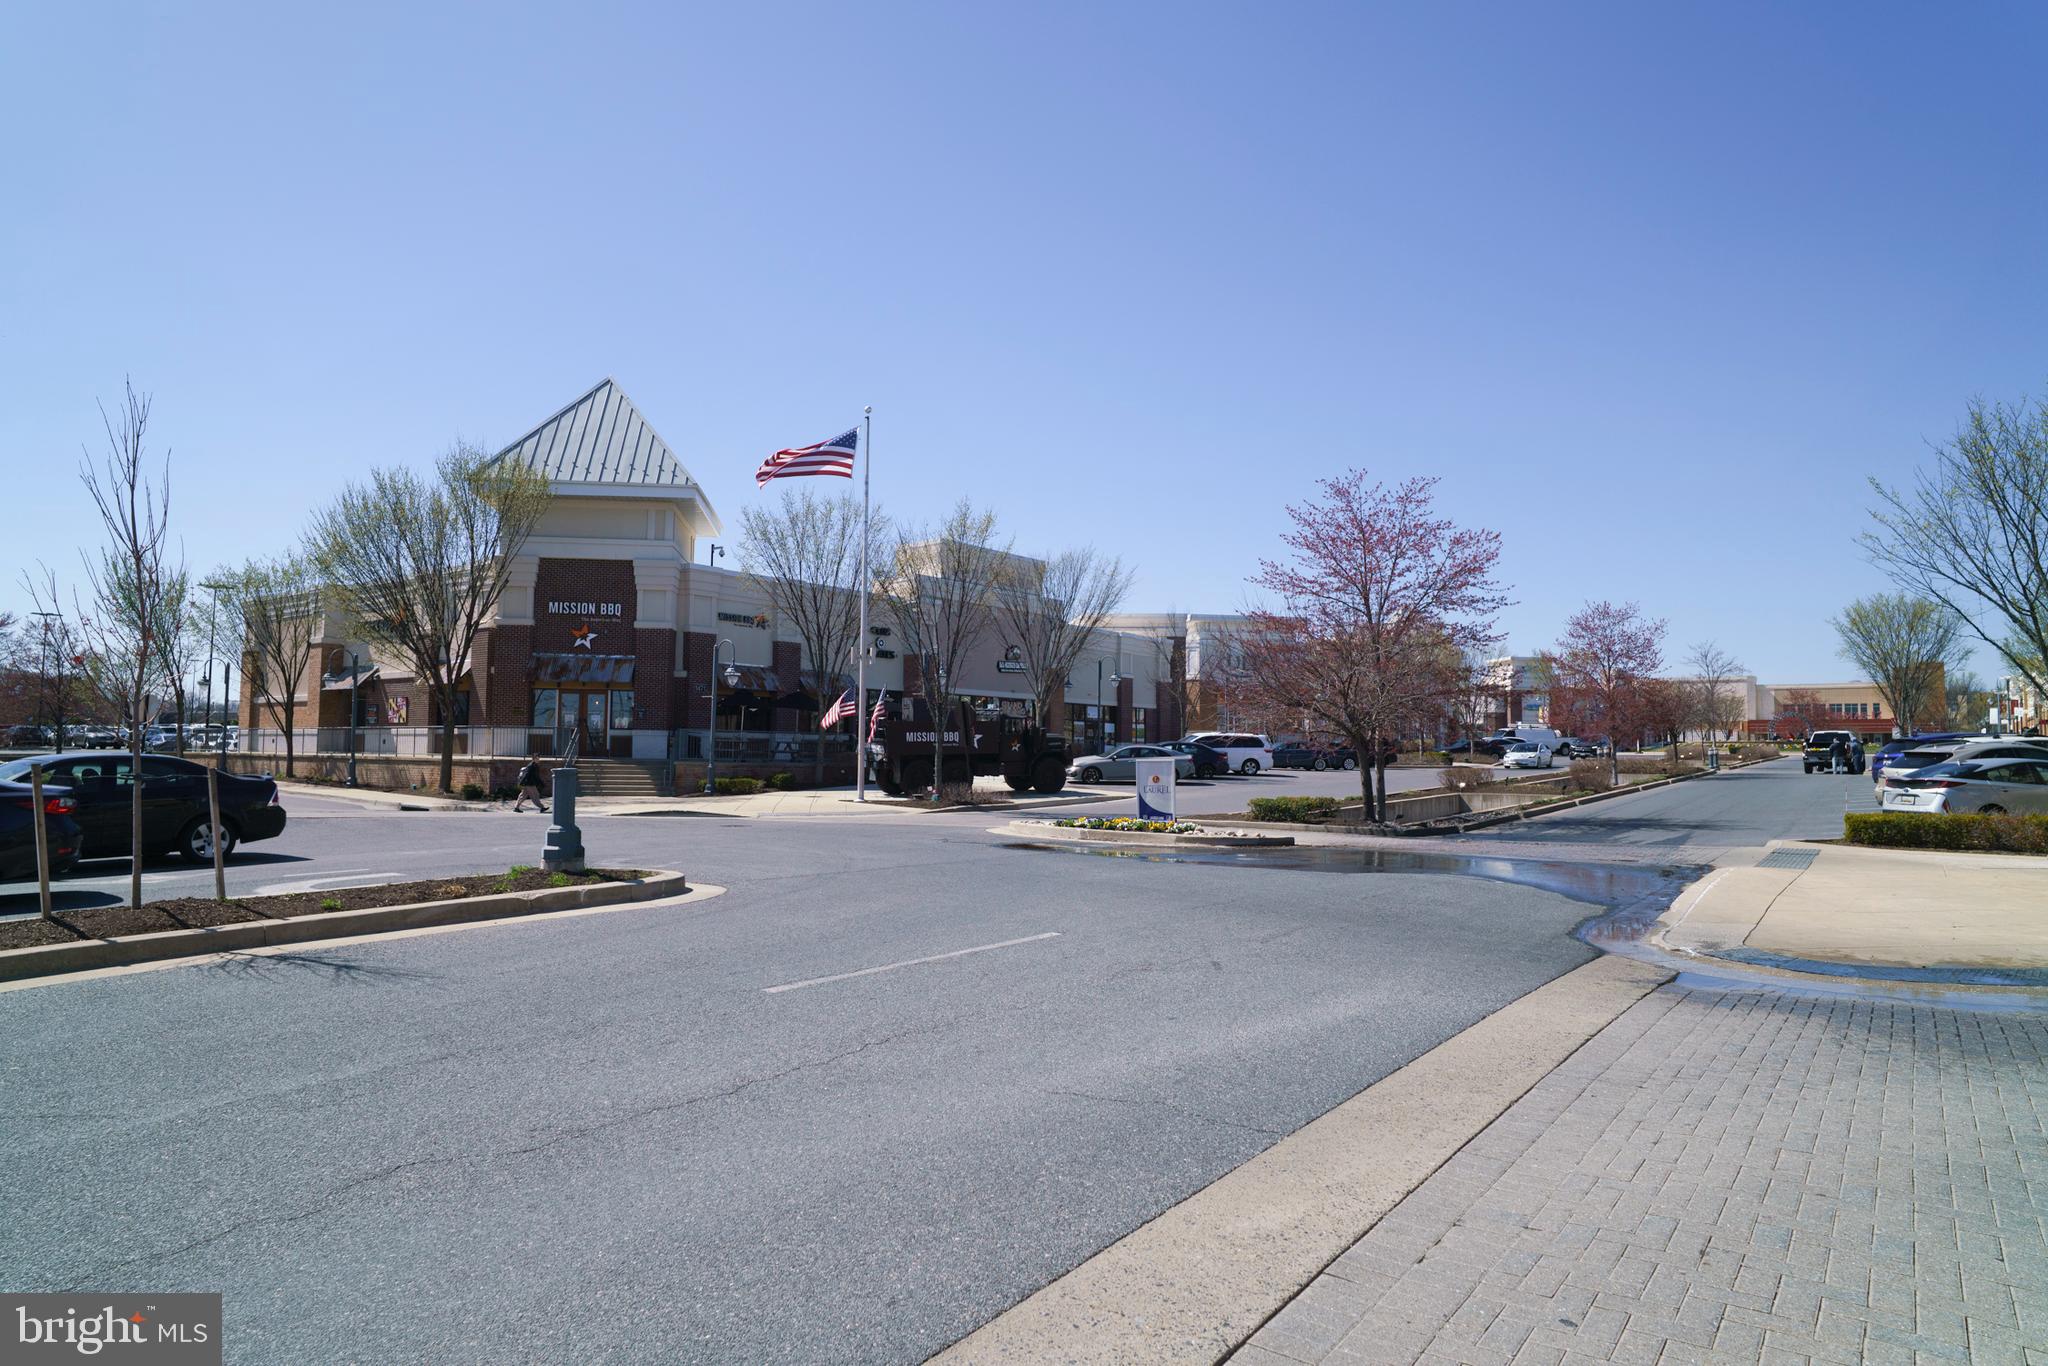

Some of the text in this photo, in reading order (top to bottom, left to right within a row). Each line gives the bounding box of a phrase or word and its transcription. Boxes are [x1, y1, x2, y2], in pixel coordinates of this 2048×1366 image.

[548, 601, 622, 617] MISSION BBQ
[943, 731, 960, 743] BBQ
